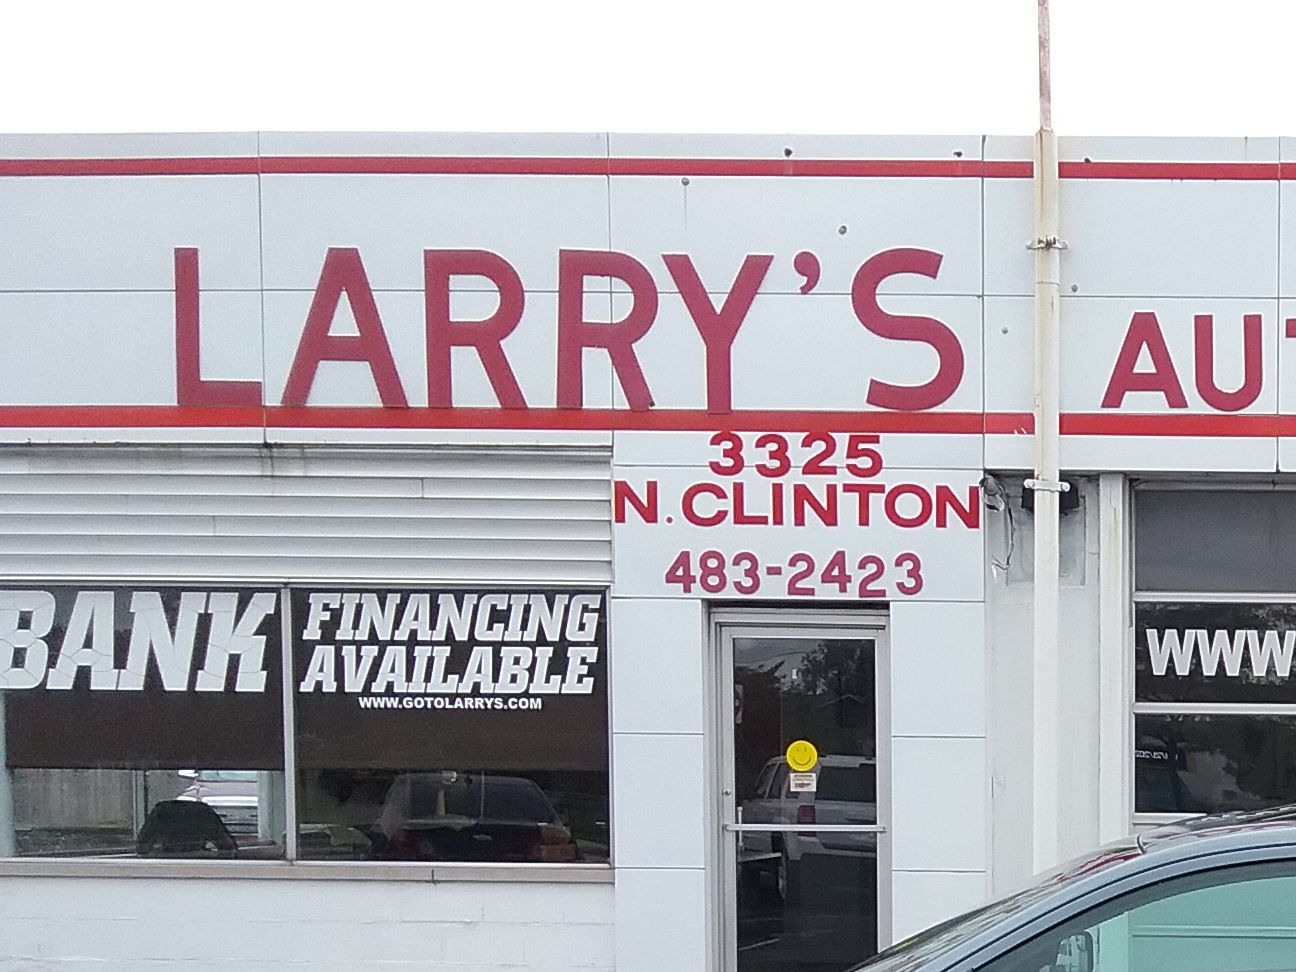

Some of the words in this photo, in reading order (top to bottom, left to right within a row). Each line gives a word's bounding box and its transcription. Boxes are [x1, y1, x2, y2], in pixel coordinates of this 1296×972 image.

[174, 247, 966, 412] LARRY'S
[708, 431, 884, 478] 3325
[665, 550, 924, 598] 483-2423
[0, 589, 278, 693] BANK
[302, 592, 602, 642] FINANCING
[299, 645, 599, 695] AVAILABLE
[358, 696, 543, 710] WWW.GOTOLARRYS.COM
